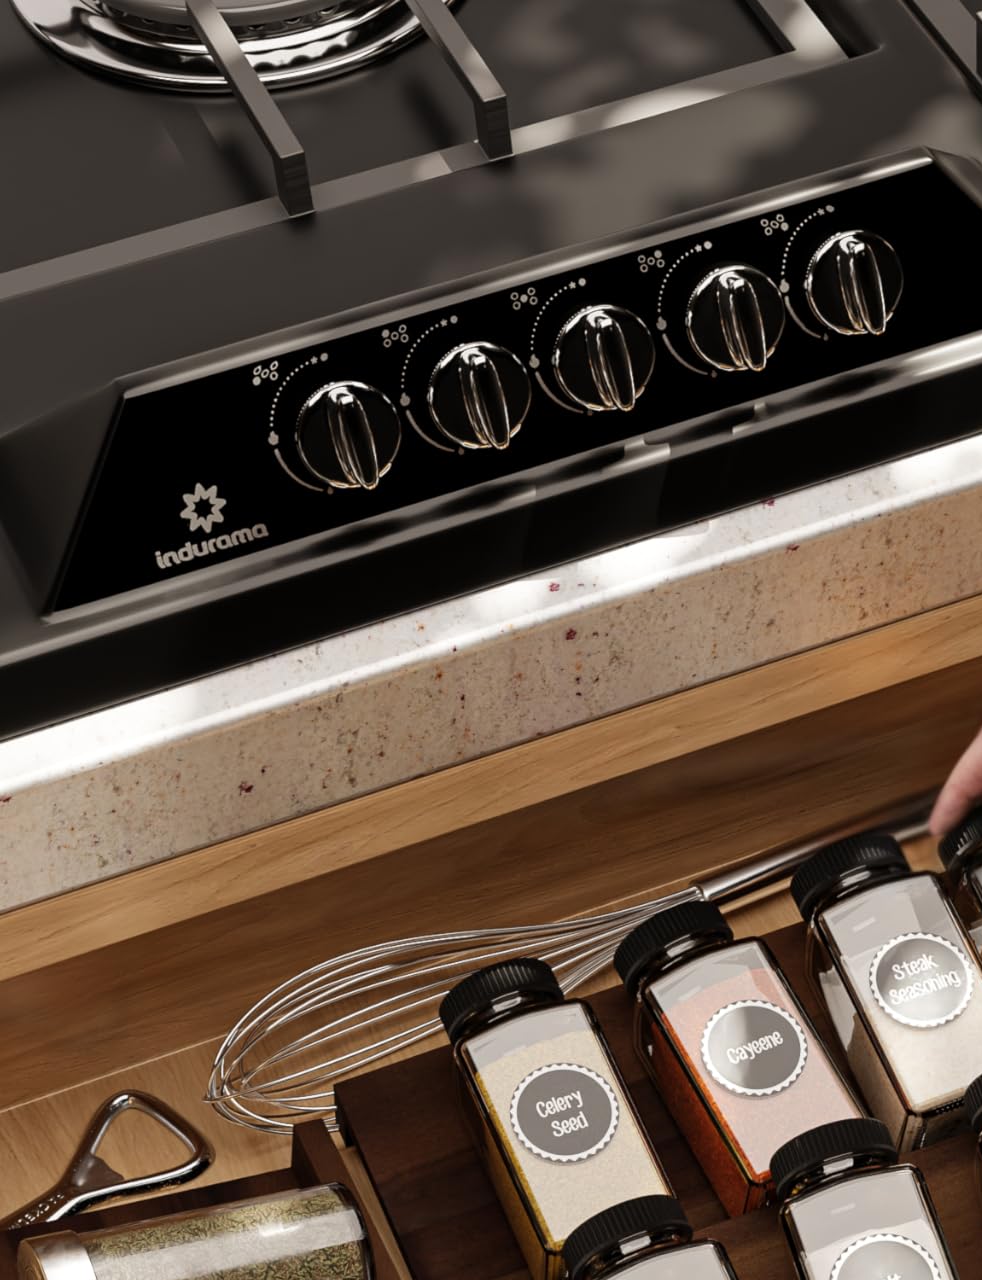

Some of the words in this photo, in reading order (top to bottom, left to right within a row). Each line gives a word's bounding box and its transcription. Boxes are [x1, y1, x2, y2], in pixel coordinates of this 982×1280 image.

[154, 523, 270, 569] indurama
[891, 953, 939, 981] Steak
[888, 970, 962, 1006] Seasoning
[726, 1030, 784, 1065] Cayeene
[535, 1090, 584, 1119] Celery
[551, 1111, 590, 1138] Seed
